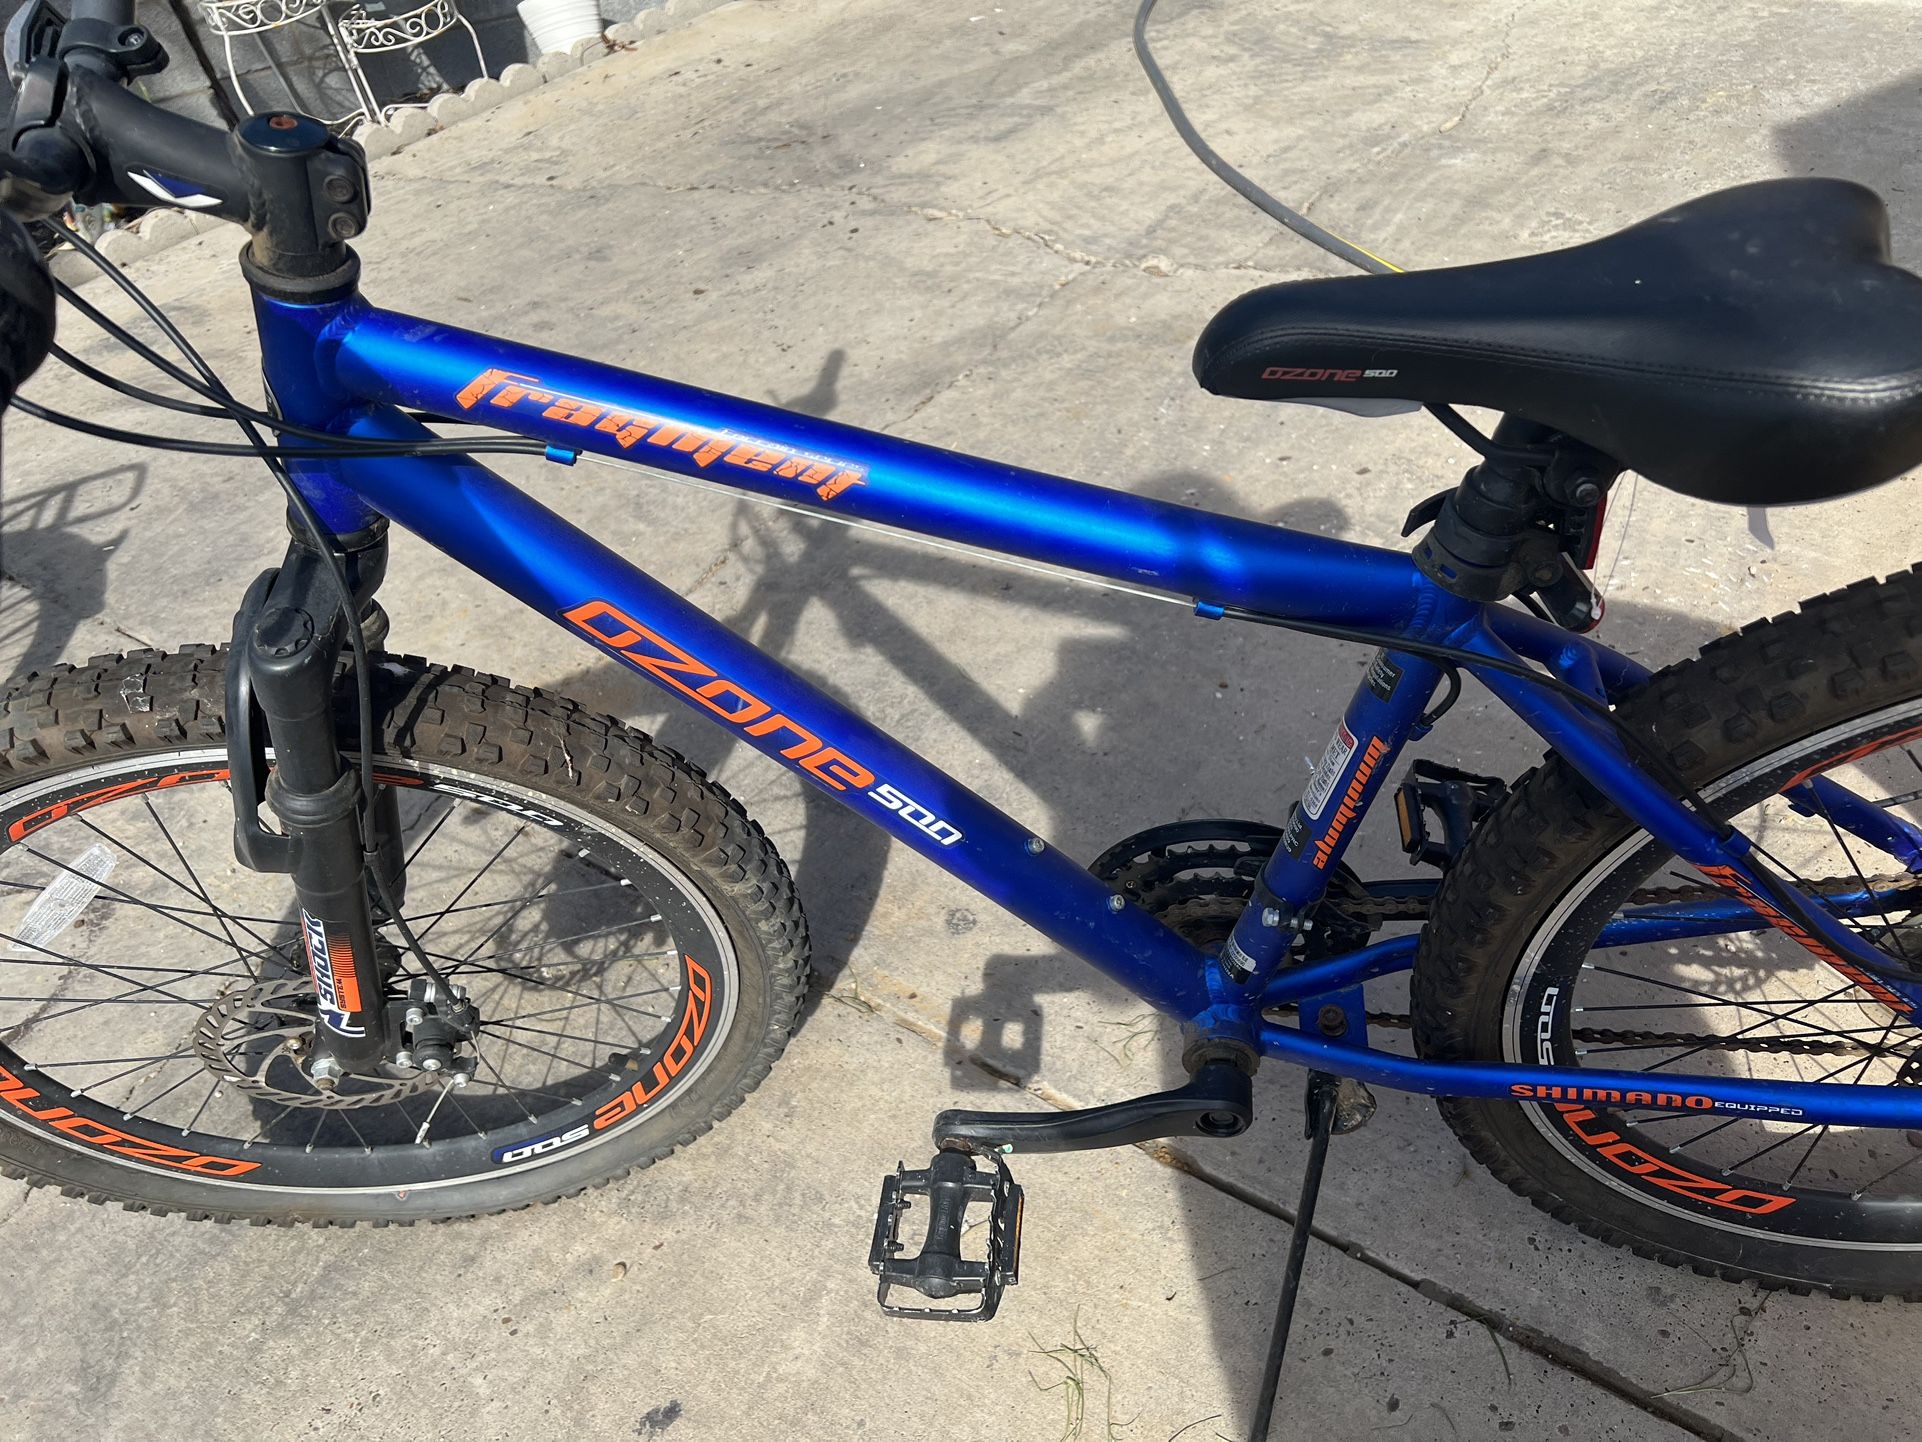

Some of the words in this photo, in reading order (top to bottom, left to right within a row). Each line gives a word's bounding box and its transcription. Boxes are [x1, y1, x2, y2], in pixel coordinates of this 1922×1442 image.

[1363, 369, 1398, 378] 500
[868, 783, 964, 846] 500
[303, 909, 336, 1006] SHOCK
[336, 978, 347, 1010] SYSTEM
[1510, 1084, 1714, 1110] SHIMANO
[1714, 1101, 1803, 1116] EQUIPPED
[501, 1123, 590, 1164] 500
